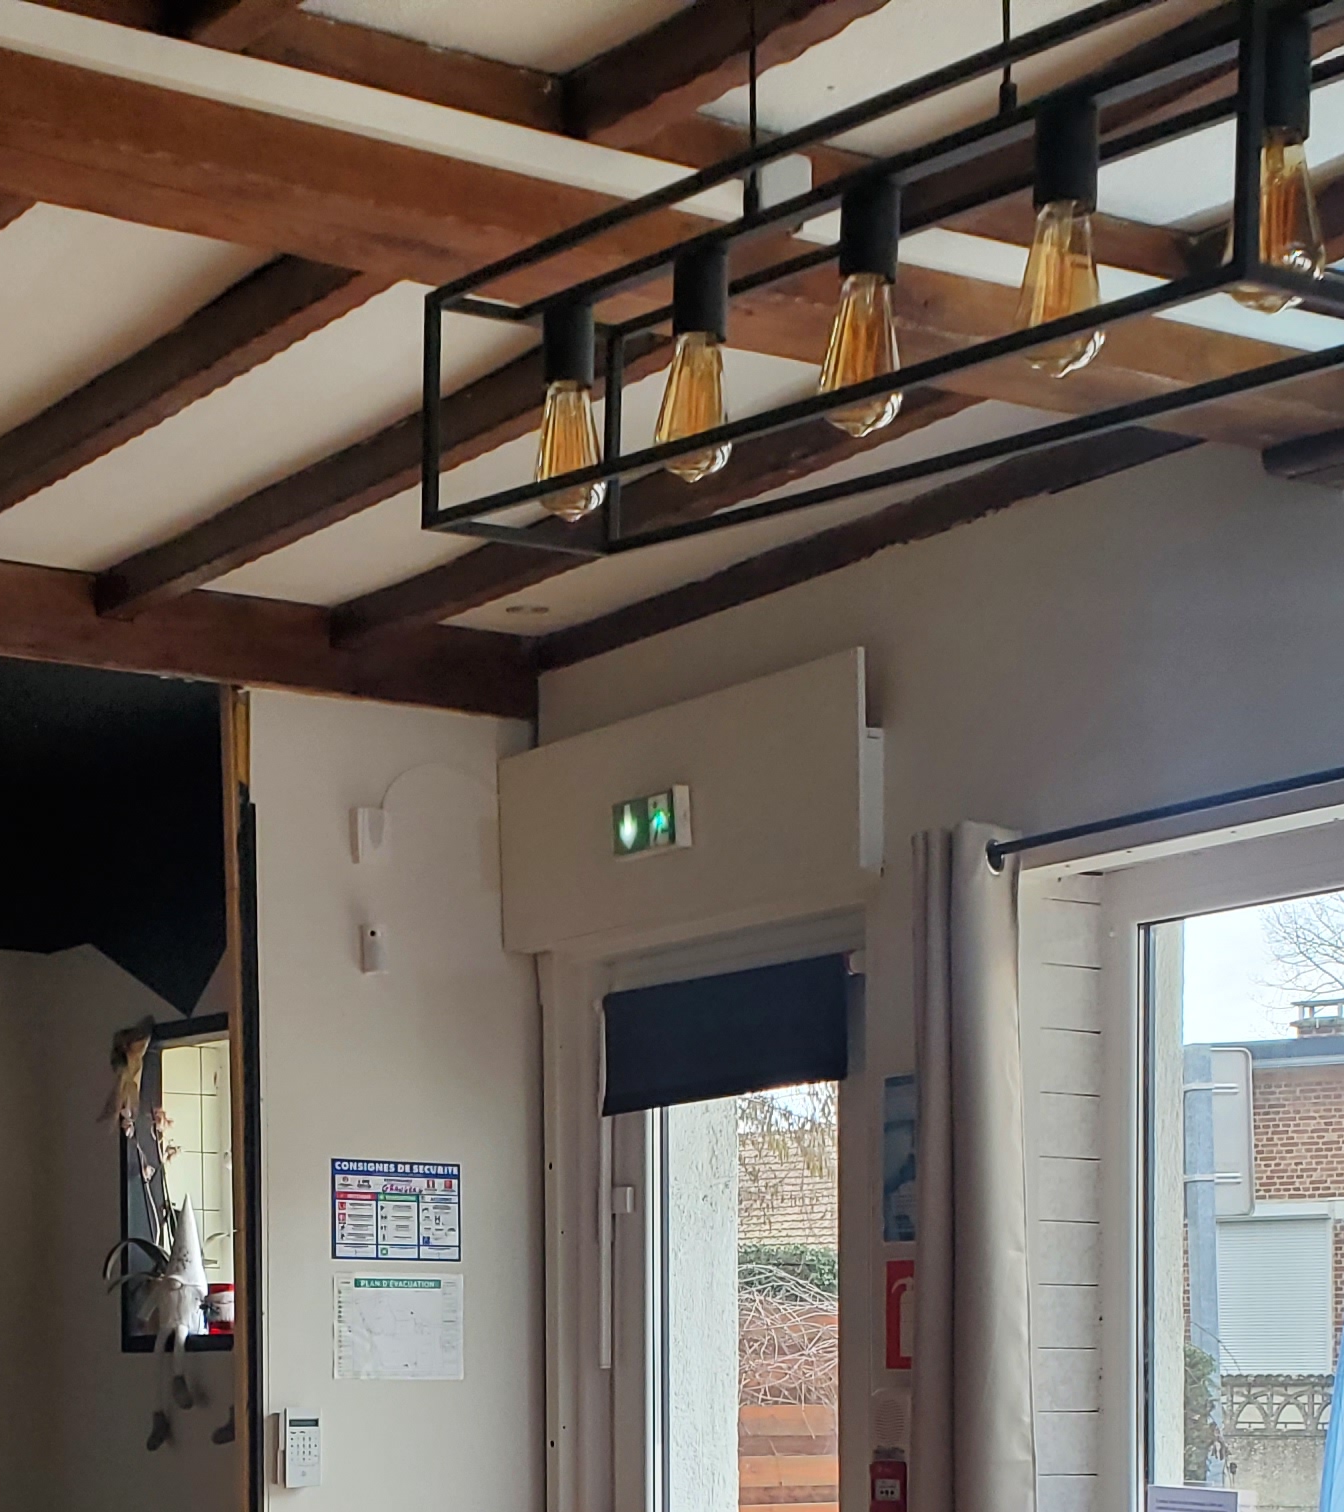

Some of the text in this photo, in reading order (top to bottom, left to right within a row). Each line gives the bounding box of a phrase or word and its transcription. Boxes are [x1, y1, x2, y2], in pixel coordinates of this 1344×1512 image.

[334, 1161, 396, 1173] CONSIGNES
[397, 1163, 411, 1173] DE
[360, 1280, 380, 1288] PLAN
